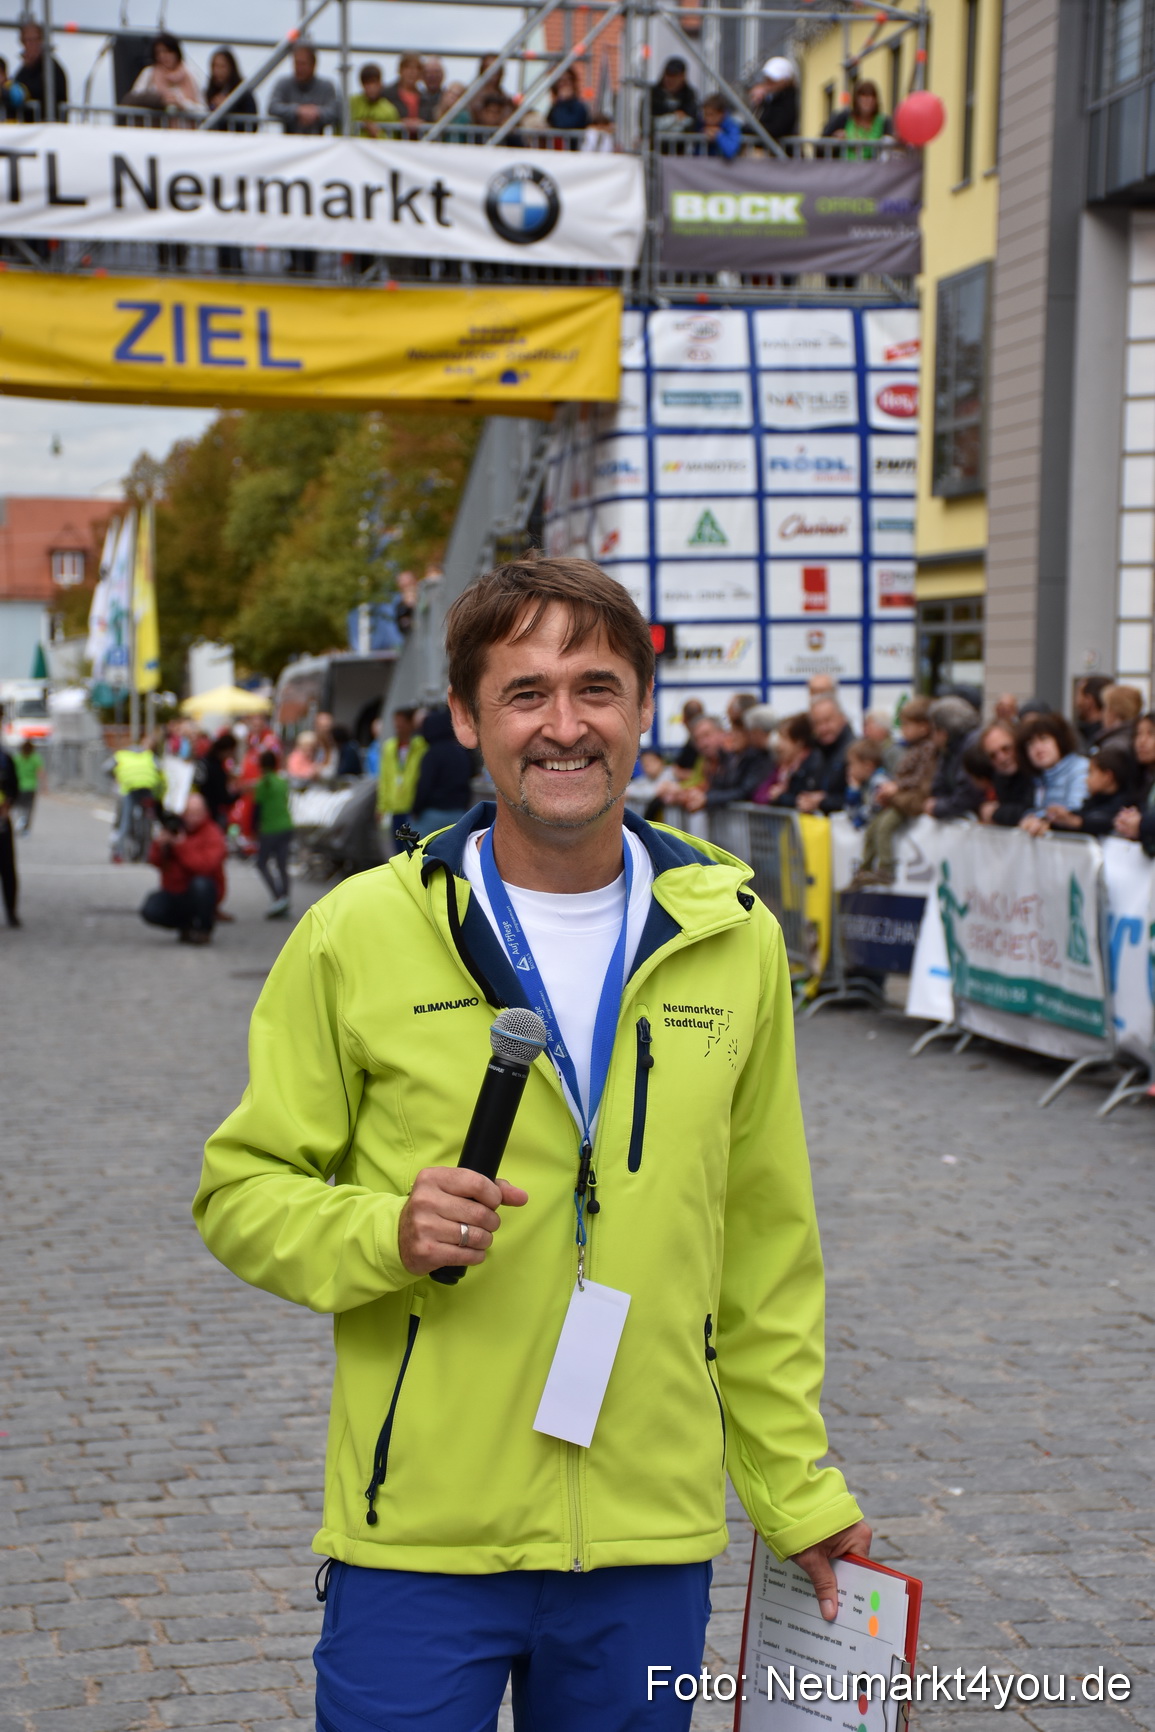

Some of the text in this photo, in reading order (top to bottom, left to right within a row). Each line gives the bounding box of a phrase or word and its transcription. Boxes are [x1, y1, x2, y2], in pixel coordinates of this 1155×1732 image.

[112, 153, 455, 227] Neumarkt
[673, 193, 803, 223] BOCK
[113, 299, 302, 369] ZIEL
[502, 920, 520, 955] Auf Pflege
[413, 997, 479, 1015] KILIMANJARO
[663, 1003, 724, 1016] Neumarkter
[664, 1018, 714, 1032] Stadtlauf
